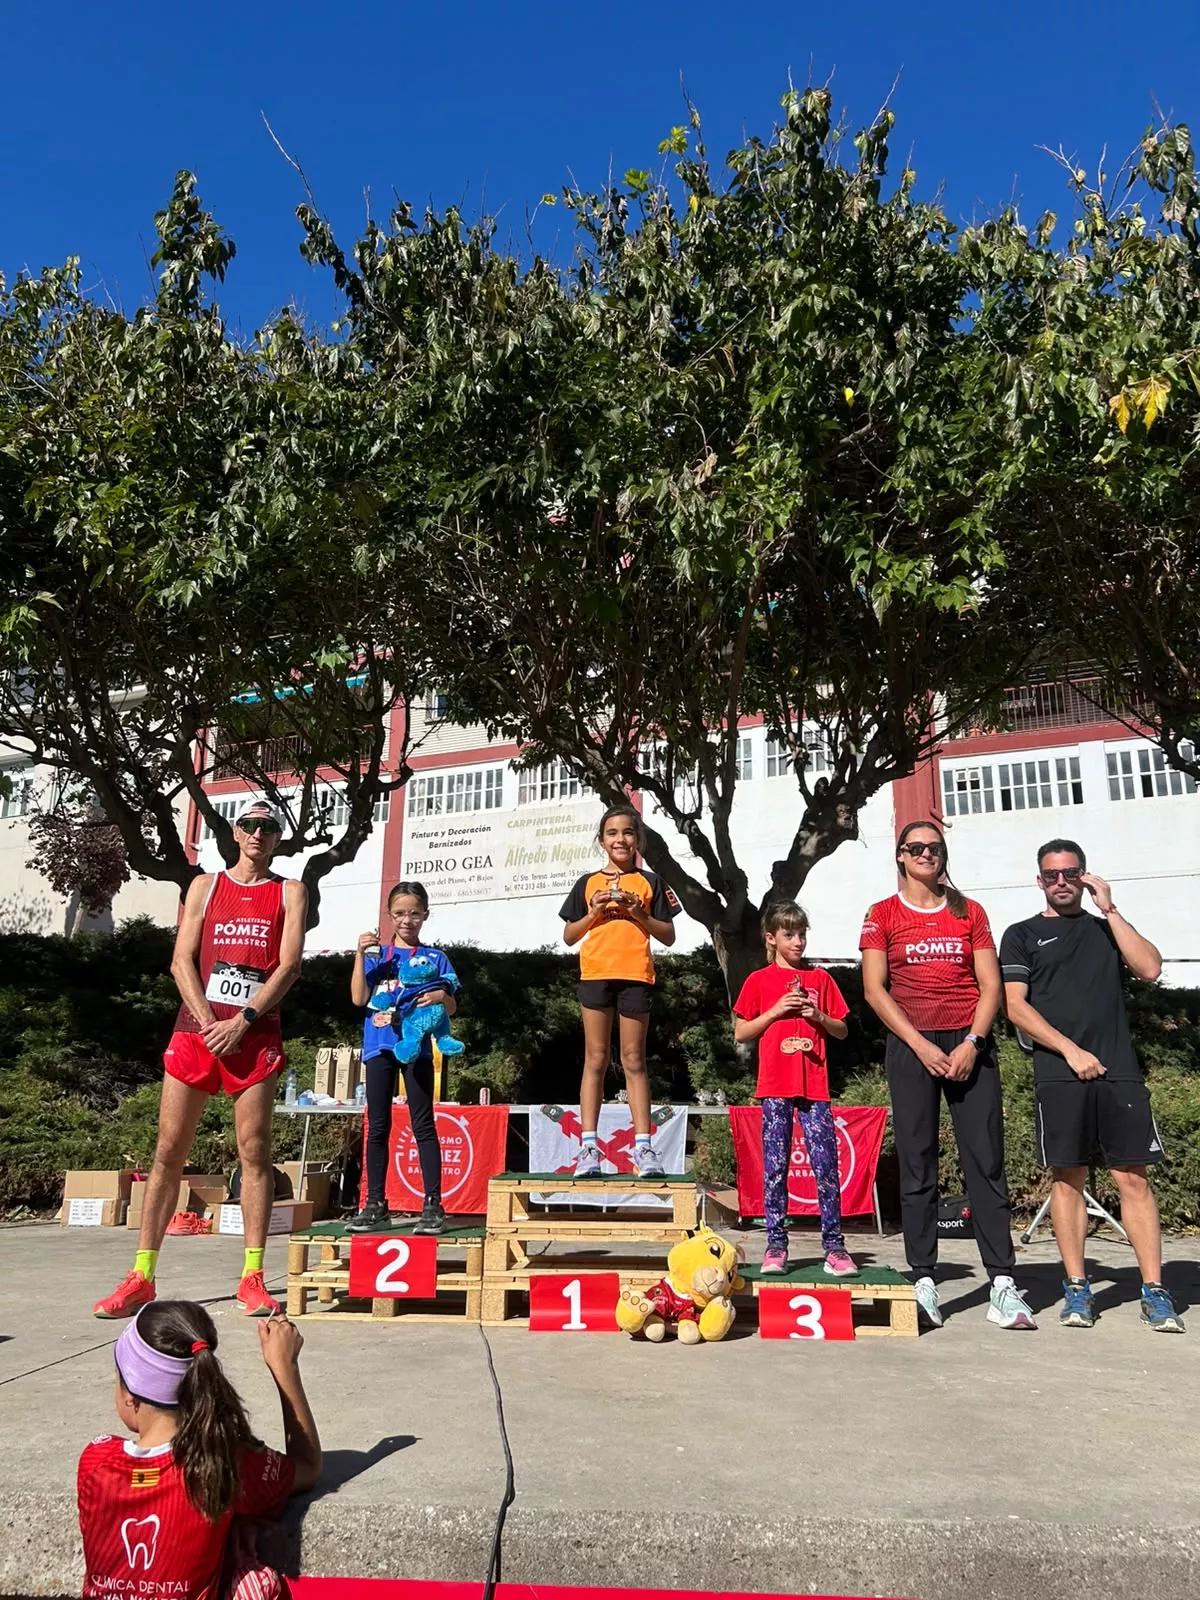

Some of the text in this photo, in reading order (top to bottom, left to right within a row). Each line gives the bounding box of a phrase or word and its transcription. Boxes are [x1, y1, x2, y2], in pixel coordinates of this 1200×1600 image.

[507, 815, 572, 829] CARPINTERIA
[411, 831, 439, 839] Pintura
[448, 825, 491, 836] Decoración
[429, 838, 472, 849] Barnizados
[504, 845, 547, 868] Alfredo
[405, 855, 494, 875] PEDRO GEA
[214, 920, 270, 938] PÓMEZ
[213, 938, 267, 947] BARBASTRO
[905, 940, 964, 955] PÓMEZ
[220, 980, 251, 999] 001
[408, 1148, 462, 1163] PEZ
[375, 1239, 410, 1293] 2
[562, 1279, 587, 1330] 1
[789, 1294, 825, 1339] 3
[139, 1580, 190, 1594] DENTAL
